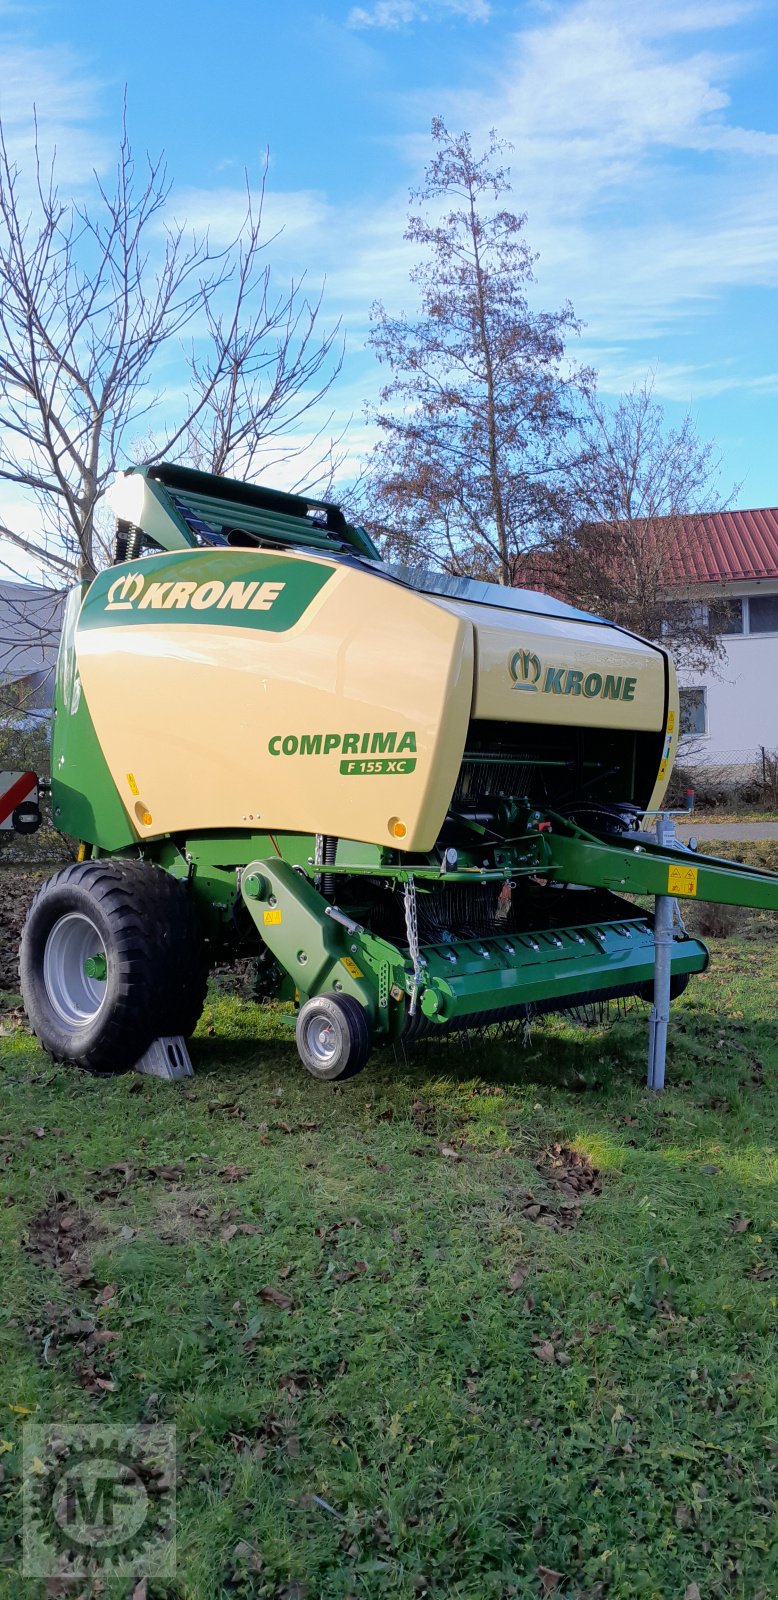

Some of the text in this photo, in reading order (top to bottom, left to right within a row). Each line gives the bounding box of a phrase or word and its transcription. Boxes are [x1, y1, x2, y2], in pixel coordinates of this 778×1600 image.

[137, 580, 286, 611] KRONE
[542, 667, 638, 701] KRONE
[268, 731, 418, 756] COMPRIMA
[347, 761, 407, 773] F 155 XC
